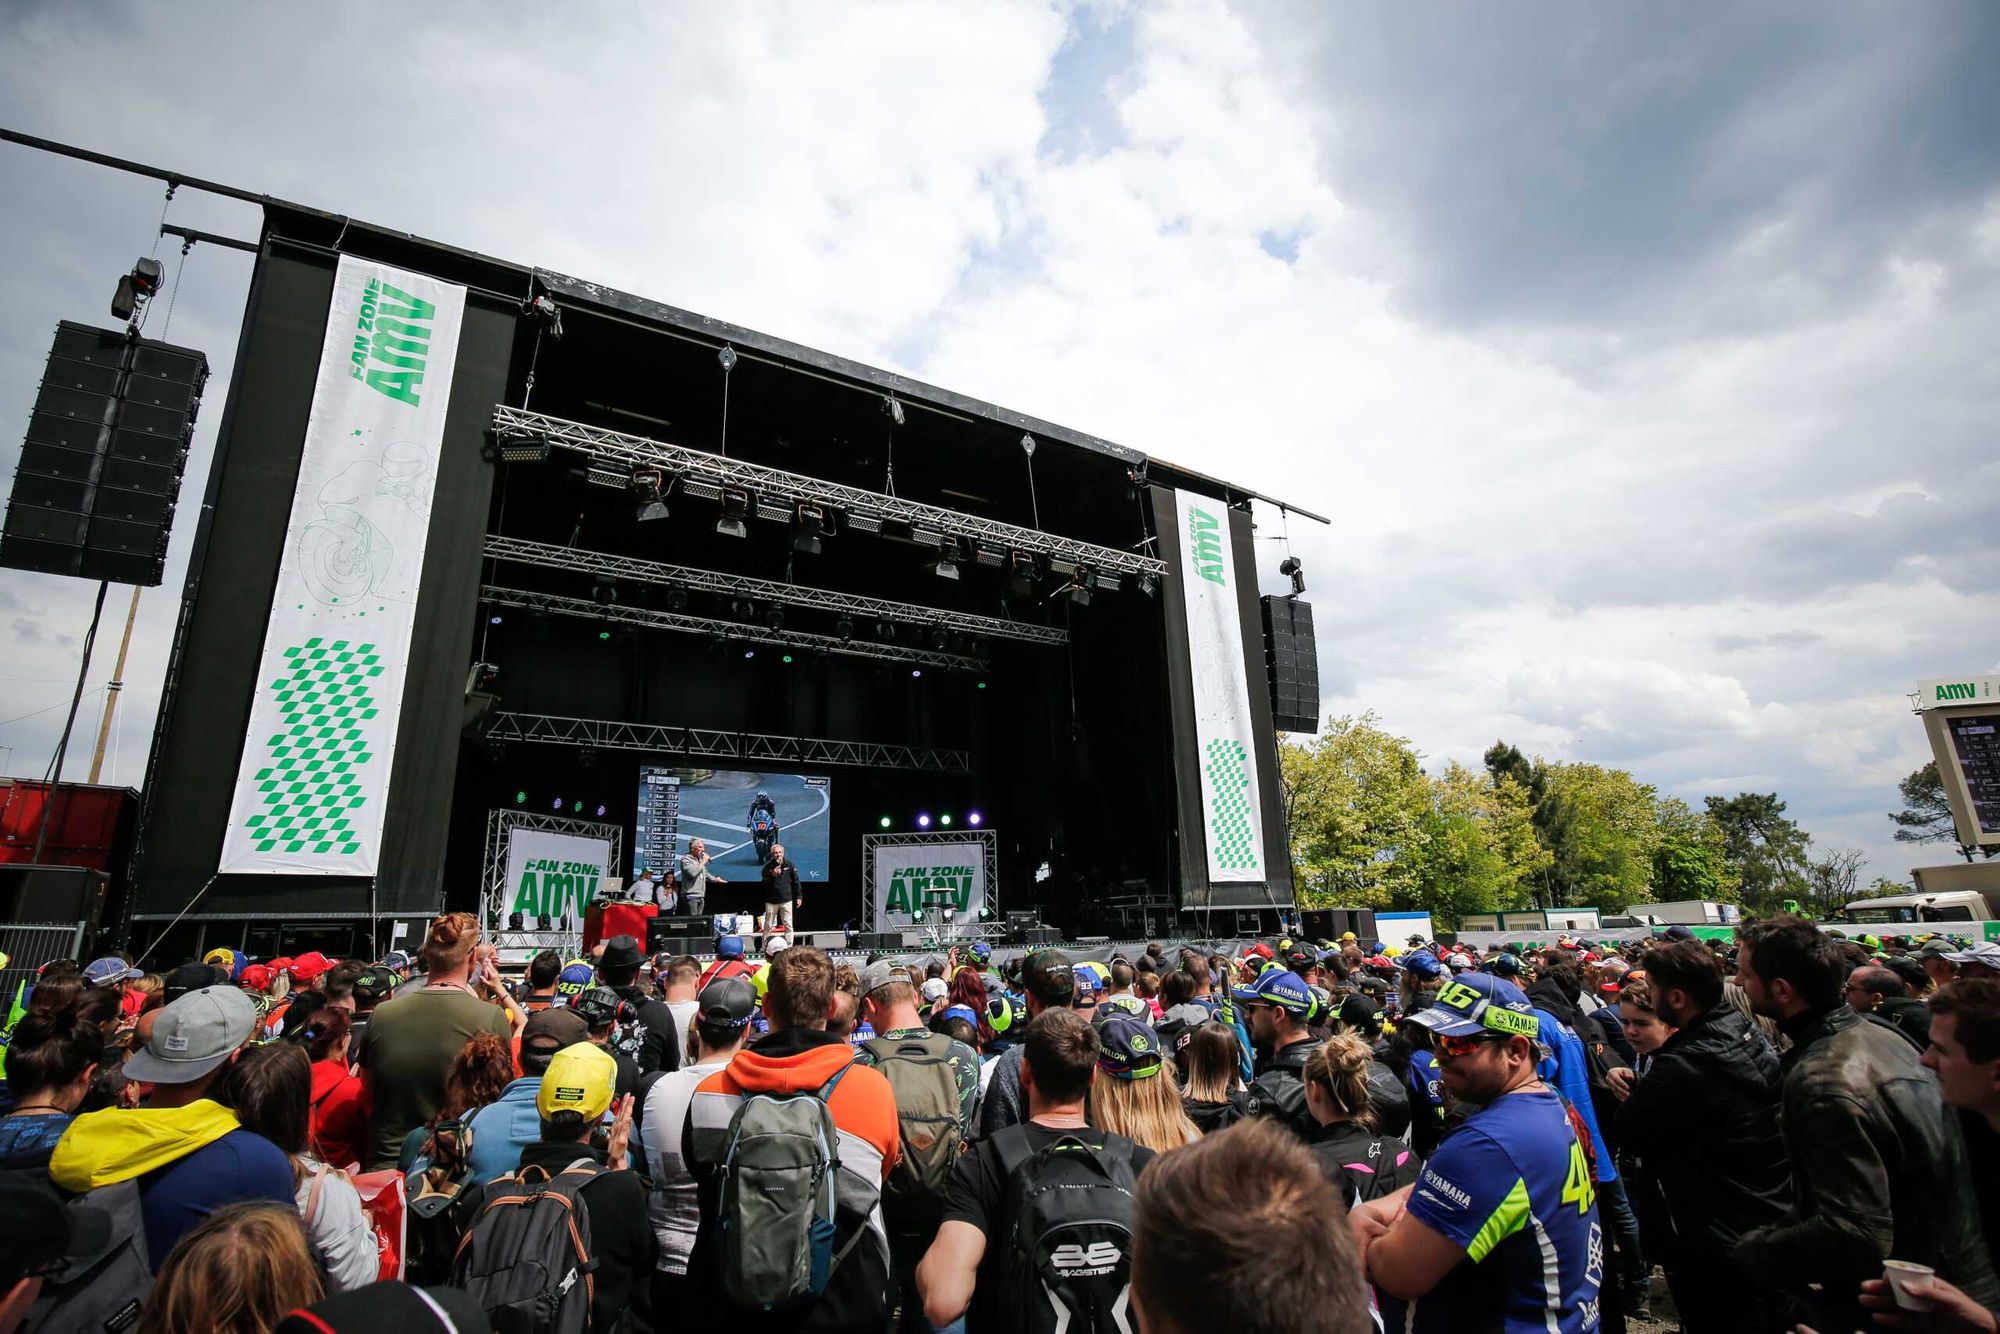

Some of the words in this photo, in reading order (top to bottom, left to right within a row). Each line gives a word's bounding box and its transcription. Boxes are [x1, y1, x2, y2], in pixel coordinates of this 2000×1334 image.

[357, 278, 380, 332] ZONE
[525, 859, 560, 872] FAN
[562, 861, 601, 876] ZONE
[893, 867, 927, 878] FAN
[931, 866, 975, 877] ZONE
[1081, 982, 1092, 990] 93
[1435, 981, 1482, 1009] 46
[1177, 1033, 1191, 1051] 93
[1562, 1139, 1595, 1214] 4
[1432, 1173, 1471, 1206] YAMAHA
